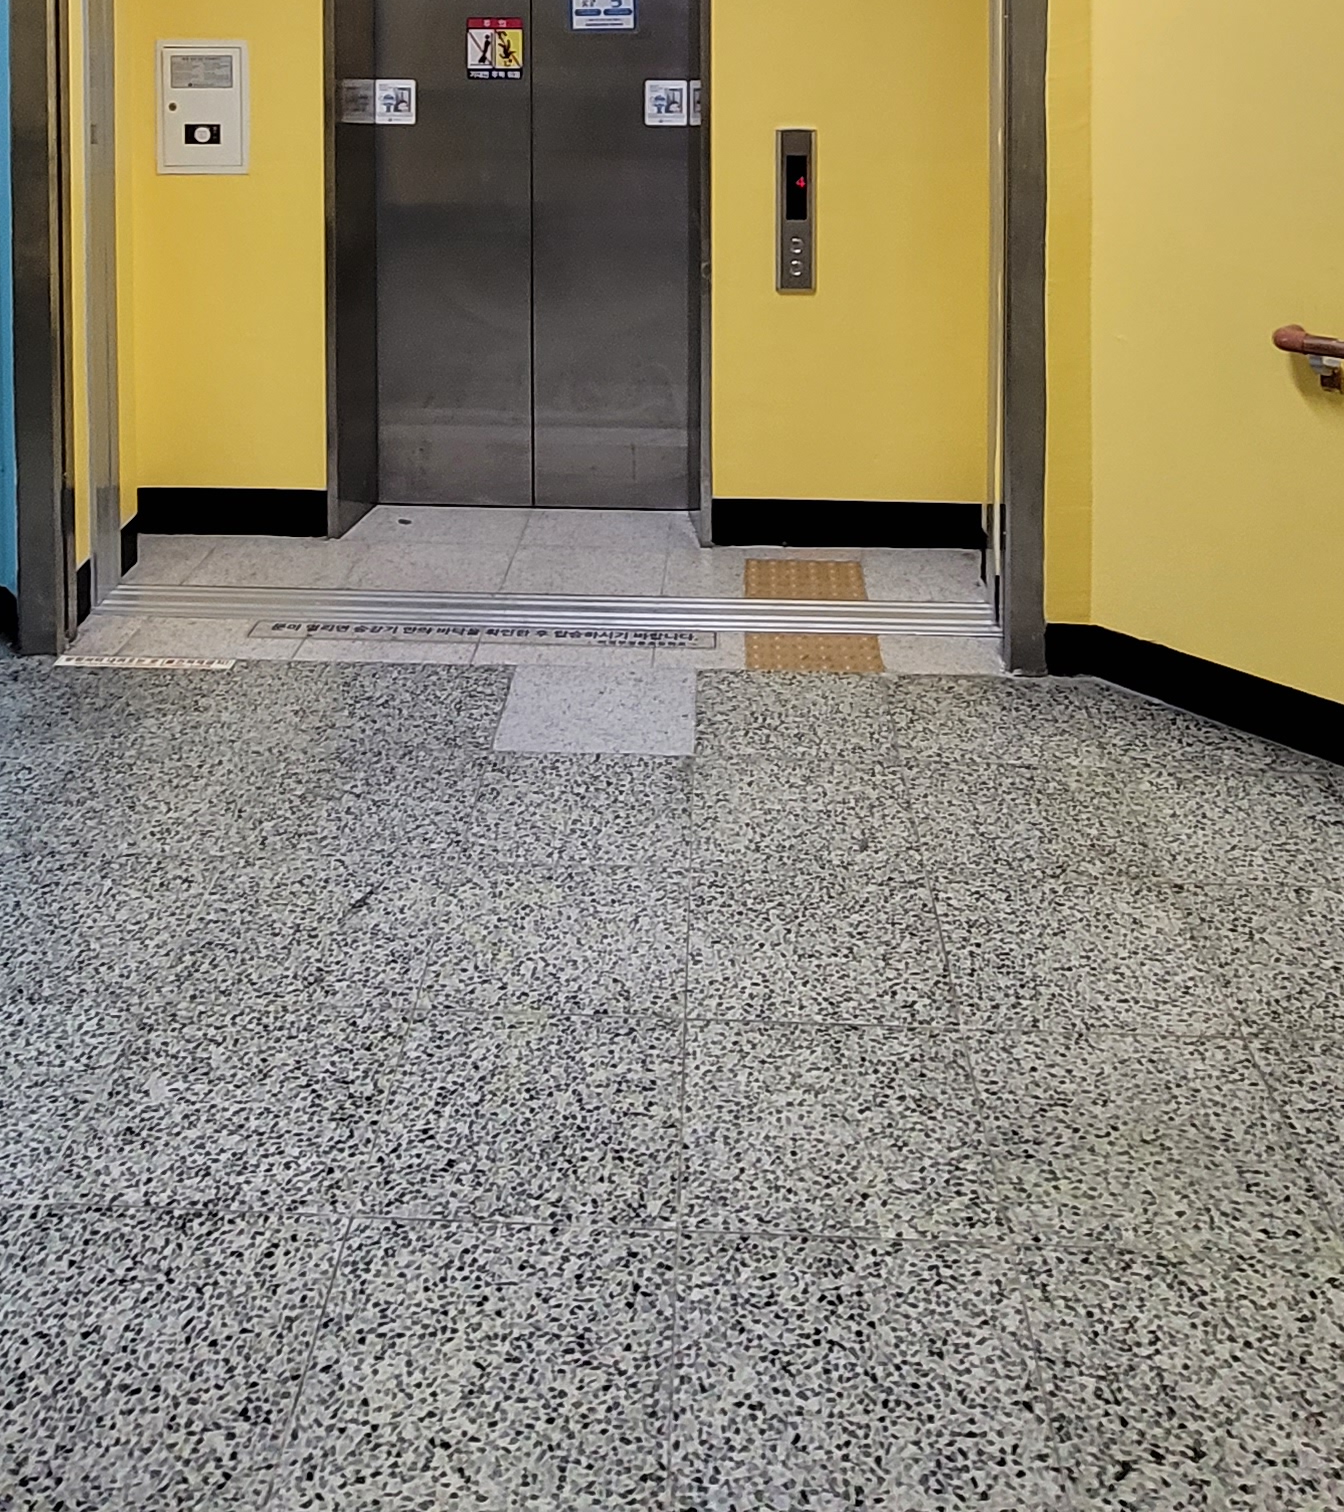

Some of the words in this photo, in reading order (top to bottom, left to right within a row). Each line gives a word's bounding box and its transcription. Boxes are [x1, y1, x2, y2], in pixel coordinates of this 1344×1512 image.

[795, 176, 806, 188] 4
[271, 622, 302, 632] 문이
[306, 623, 350, 633] 열리면
[354, 624, 398, 634] 승강기
[403, 626, 432, 635] 안의
[436, 627, 480, 636] 바닥을
[485, 628, 530, 637] 확인한
[535, 629, 548, 638] 후
[554, 630, 628, 640] 탑승하시기
